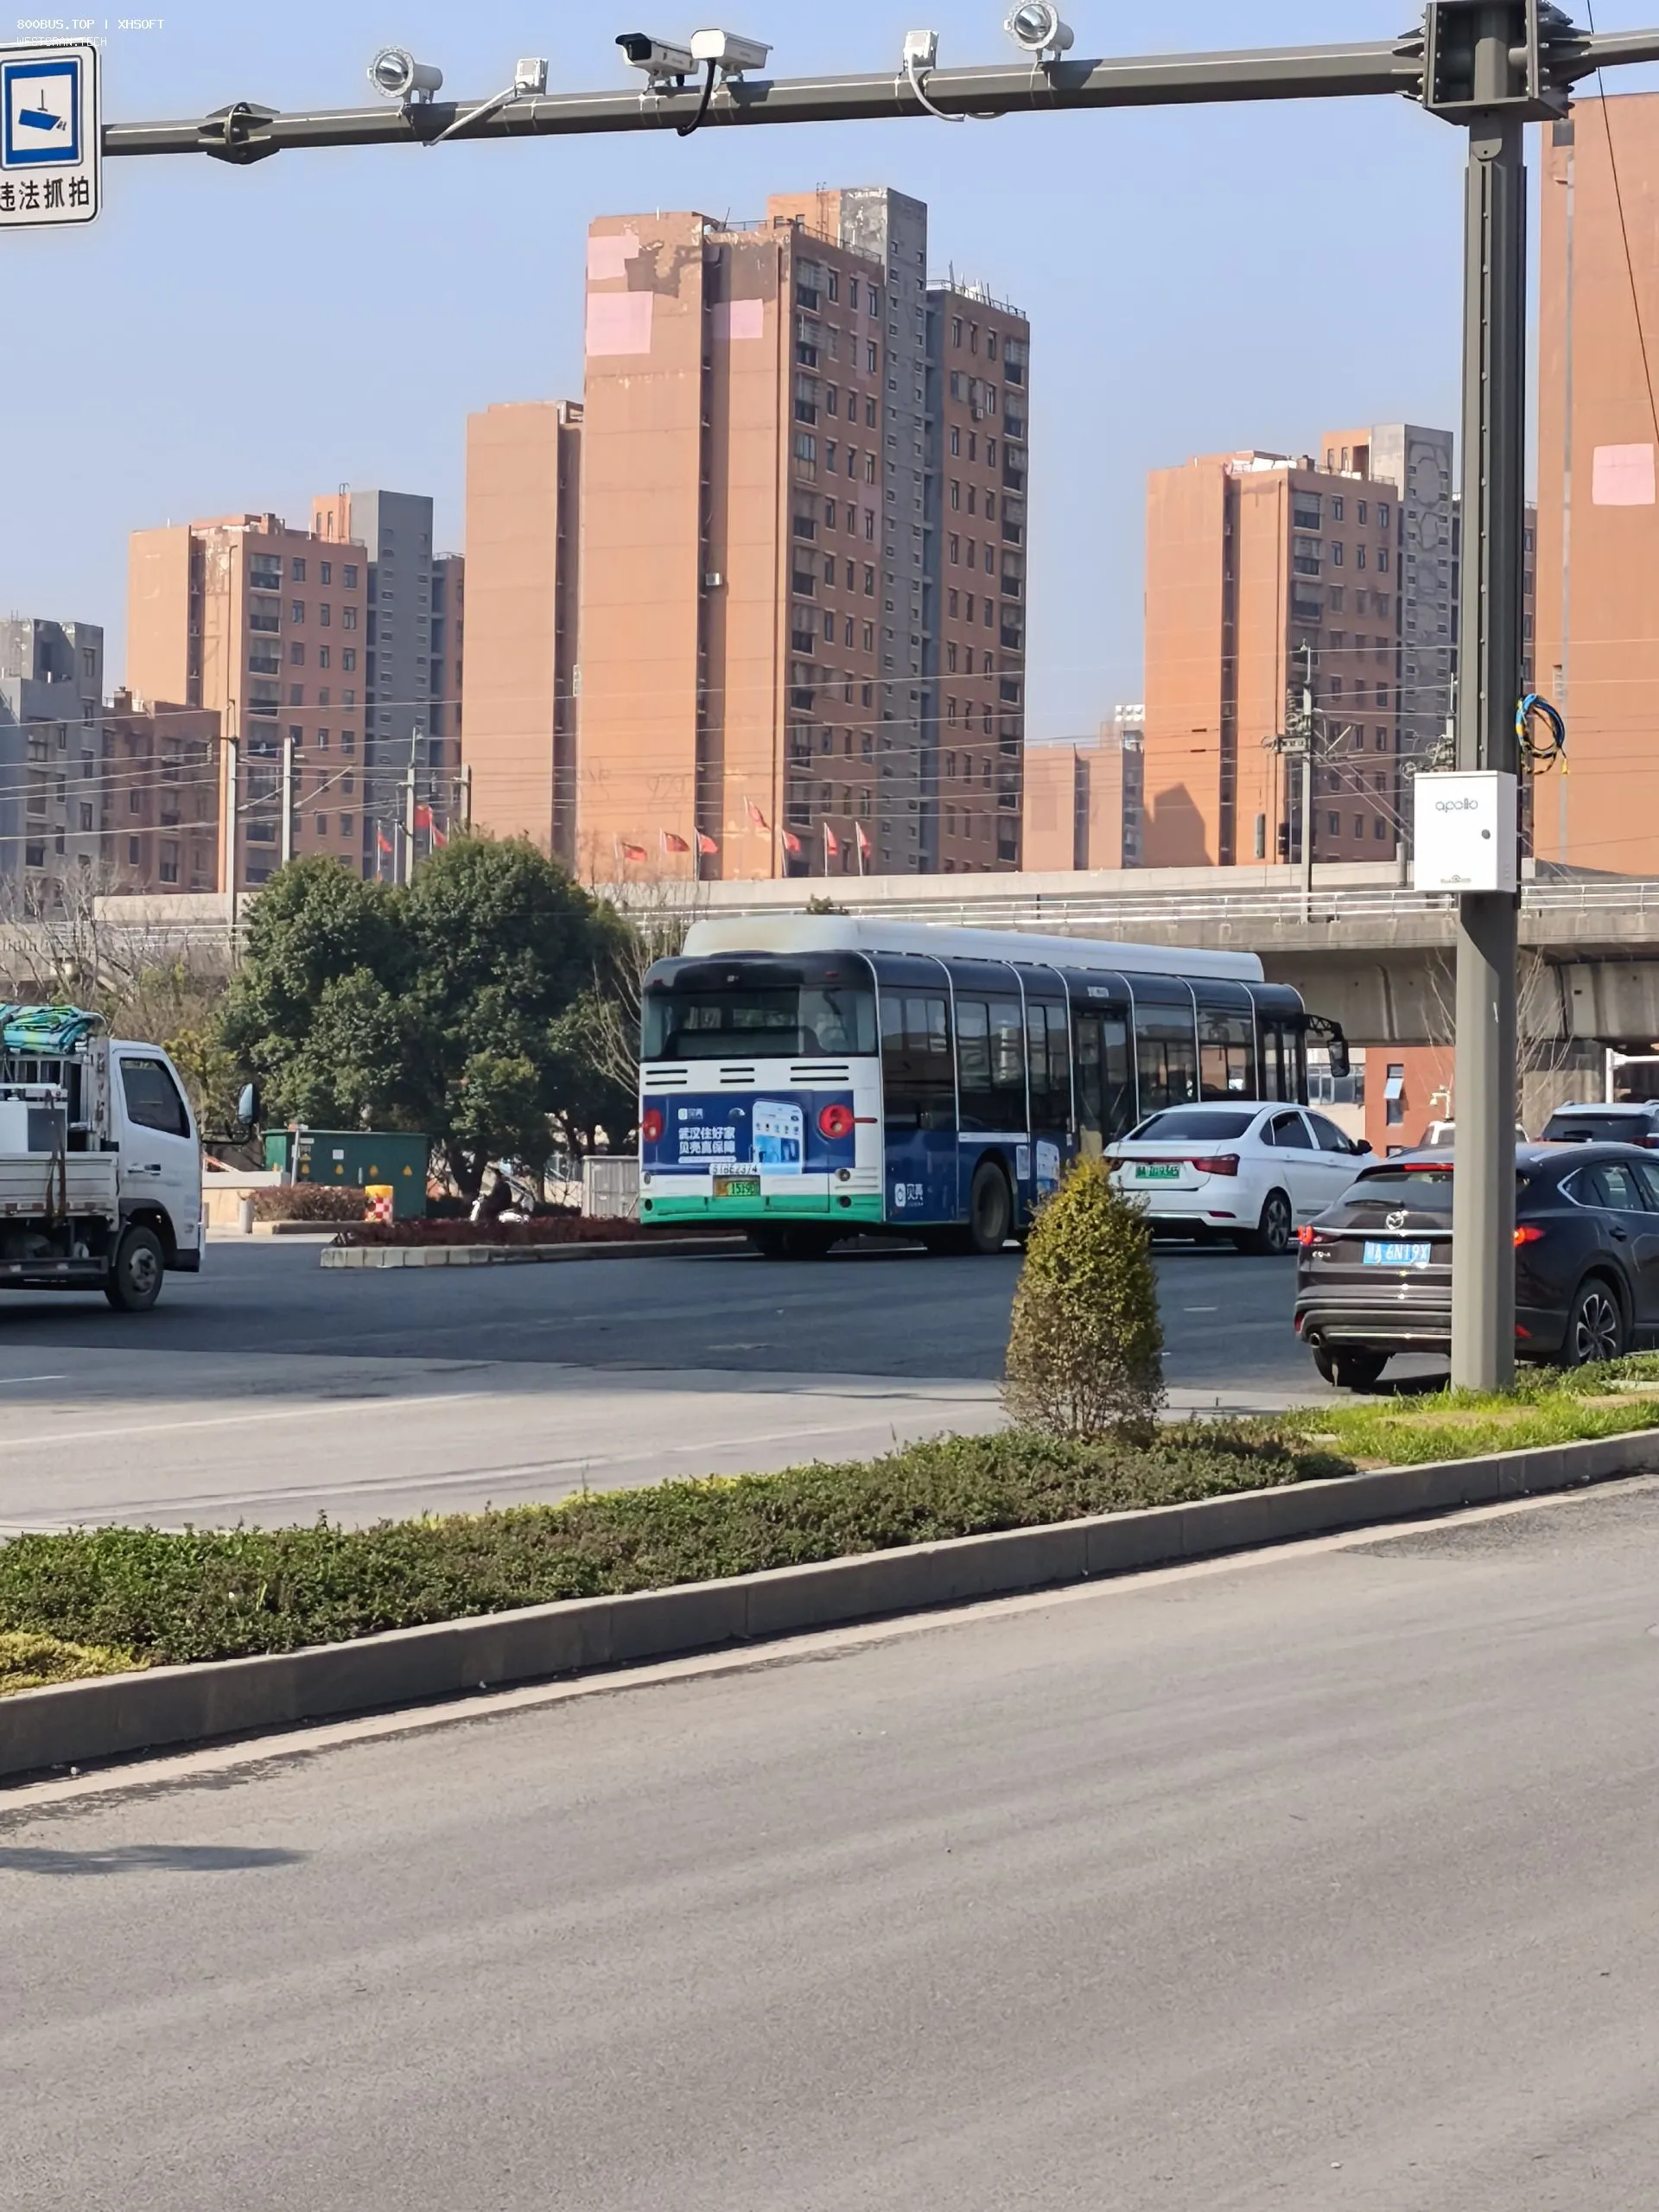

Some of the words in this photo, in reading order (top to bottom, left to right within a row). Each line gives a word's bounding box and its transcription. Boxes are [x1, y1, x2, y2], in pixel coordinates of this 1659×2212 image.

[0, 176, 90, 213] 违法抓拍
[1435, 798, 1478, 813] apollo
[678, 1127, 735, 1140] 武汉住好家
